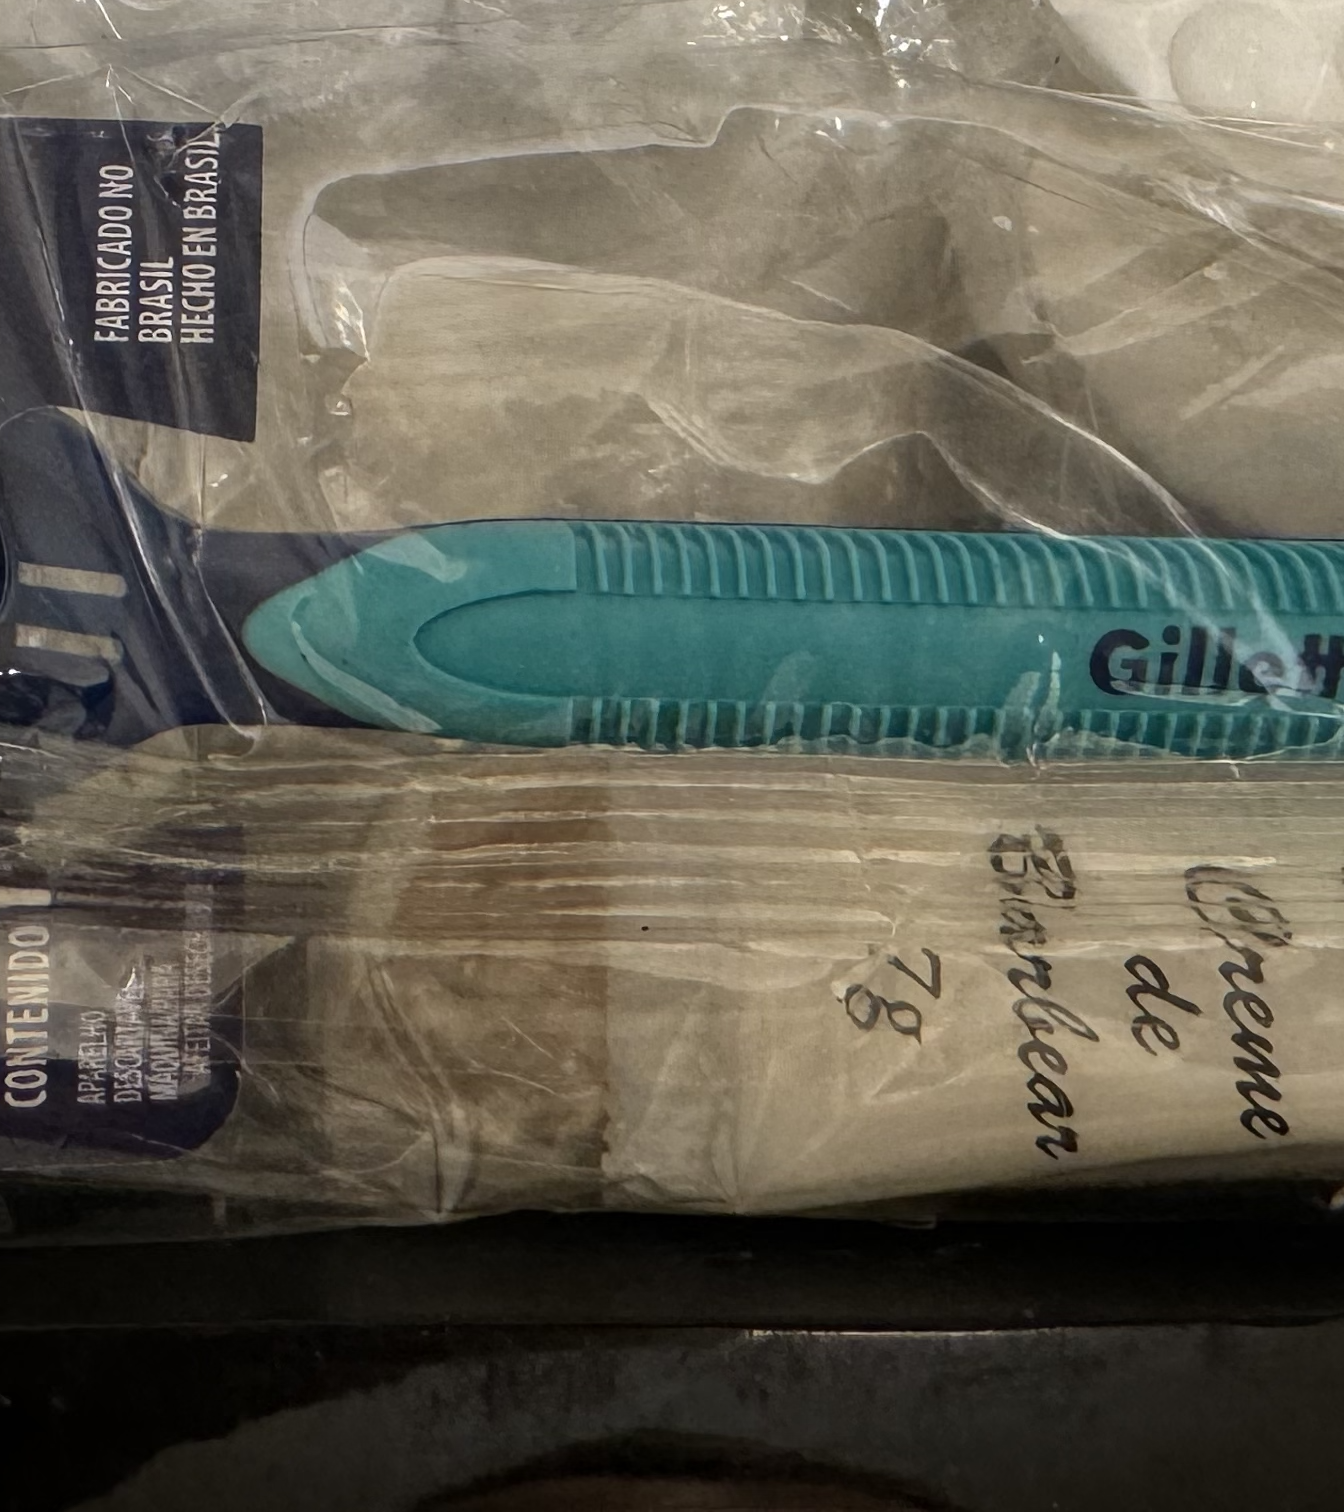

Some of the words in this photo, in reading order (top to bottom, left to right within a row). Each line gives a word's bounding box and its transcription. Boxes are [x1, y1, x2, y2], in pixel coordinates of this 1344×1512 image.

[98, 165, 133, 198] NO
[183, 132, 220, 219] BRASIL
[94, 206, 132, 342] FABRICADO
[182, 227, 217, 256] EN
[138, 256, 174, 342] BRASIL
[180, 264, 215, 343] HECHO
[4, 926, 49, 1107] CONTENIDO
[843, 947, 942, 1045] 7g
[987, 824, 1099, 1160] Barbear
[1124, 954, 1202, 1056] de
[1185, 864, 1292, 1140] Creme
